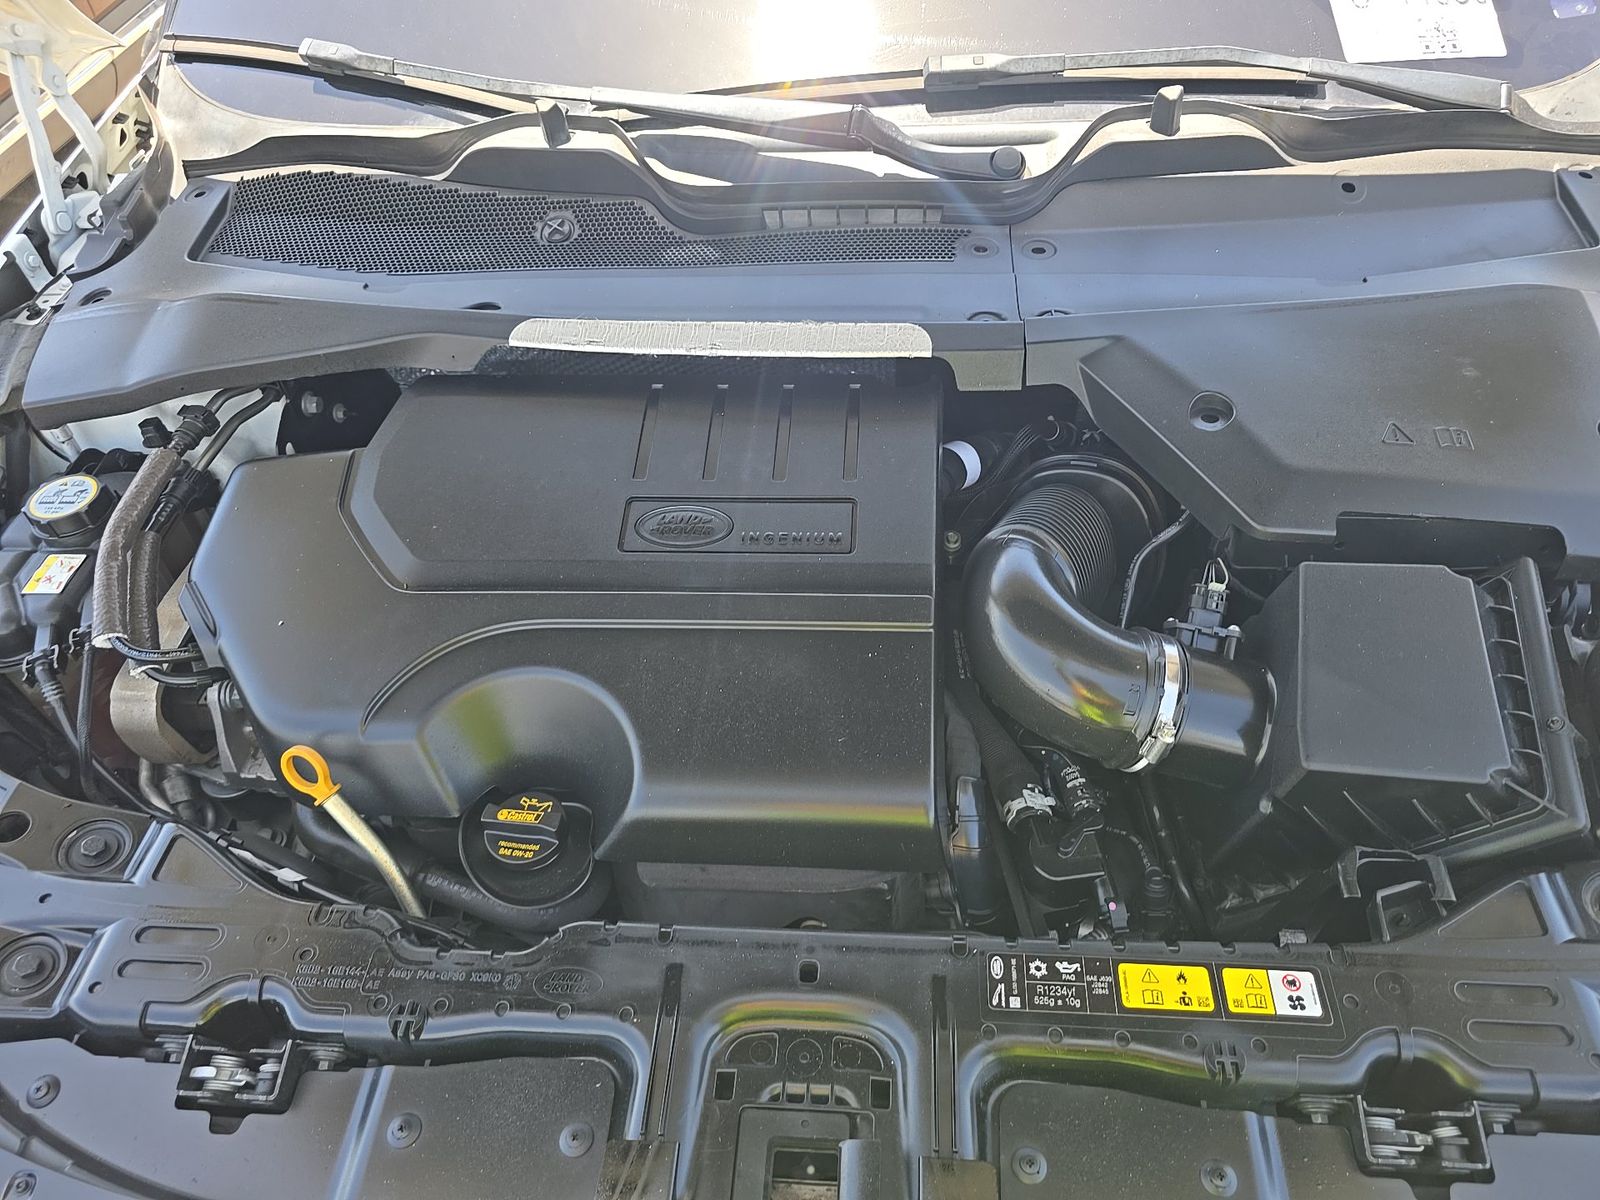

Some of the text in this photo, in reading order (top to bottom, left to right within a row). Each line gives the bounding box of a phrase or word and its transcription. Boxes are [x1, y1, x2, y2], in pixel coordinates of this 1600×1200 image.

[740, 531, 843, 546] INGENIUM
[507, 811, 536, 821] Castrol
[498, 840, 541, 851] recommended
[498, 847, 534, 858] SAE 0W-20
[1086, 974, 1099, 982] SAE
[1036, 984, 1076, 998] R1234yf
[1034, 995, 1055, 1007] 525g
[1065, 997, 1081, 1008] 10g
